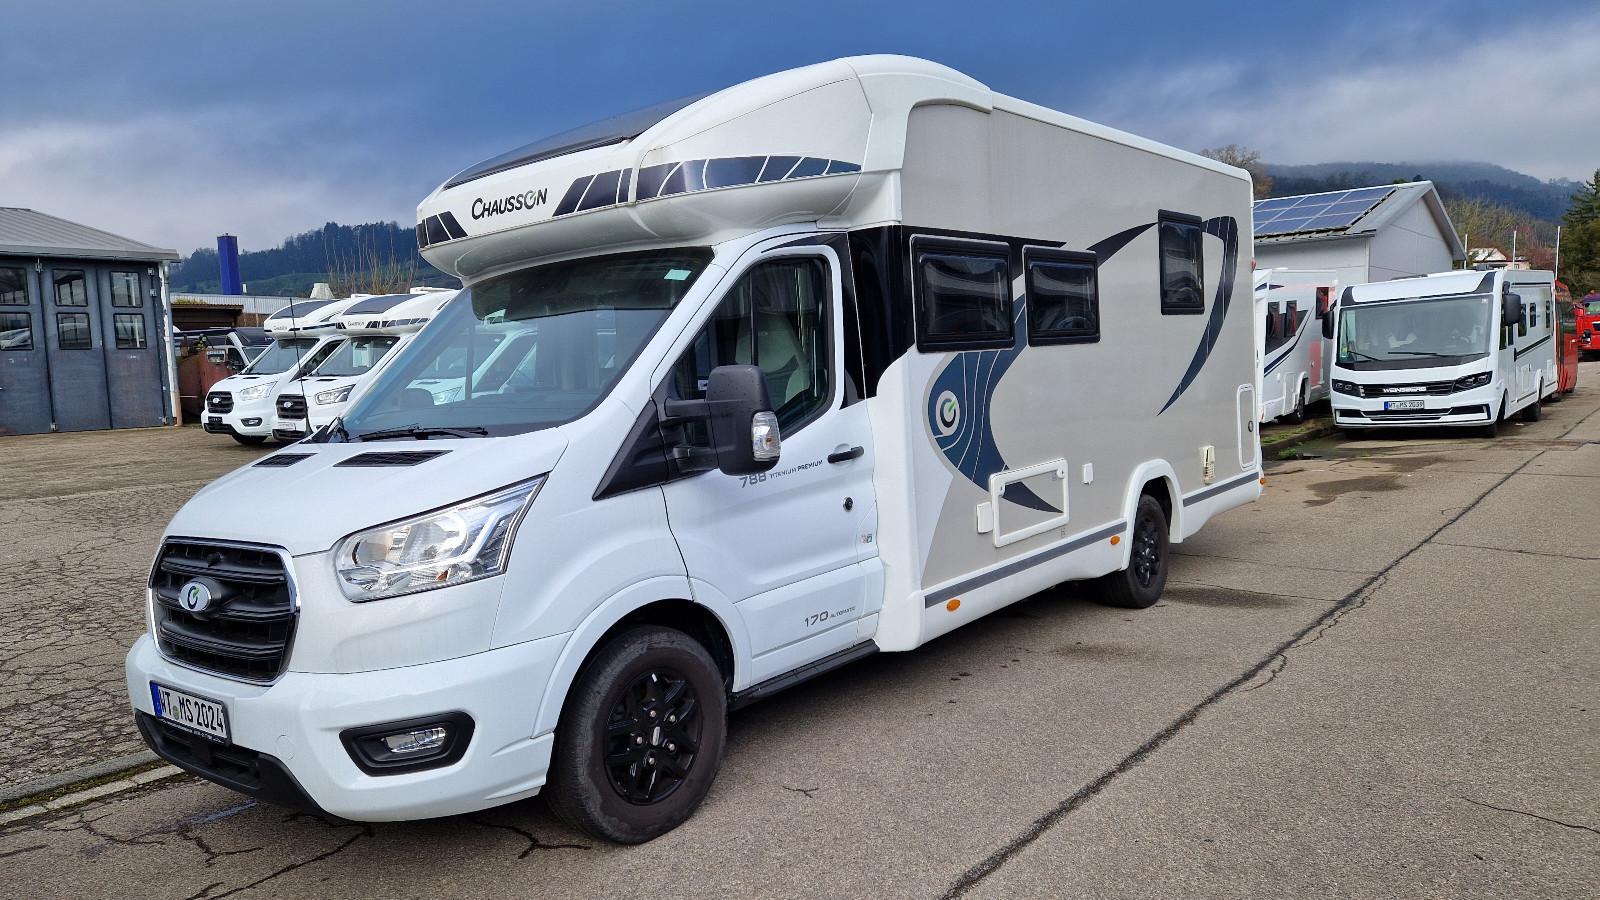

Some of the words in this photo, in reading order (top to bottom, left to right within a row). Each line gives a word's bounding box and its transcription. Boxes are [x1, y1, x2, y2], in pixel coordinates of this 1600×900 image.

[472, 188, 548, 220] CHAUSSON
[739, 472, 767, 488] 788
[797, 459, 823, 472] PREMIUM
[804, 611, 829, 627] 170
[178, 695, 194, 723] MS
[195, 701, 225, 734] 2024
